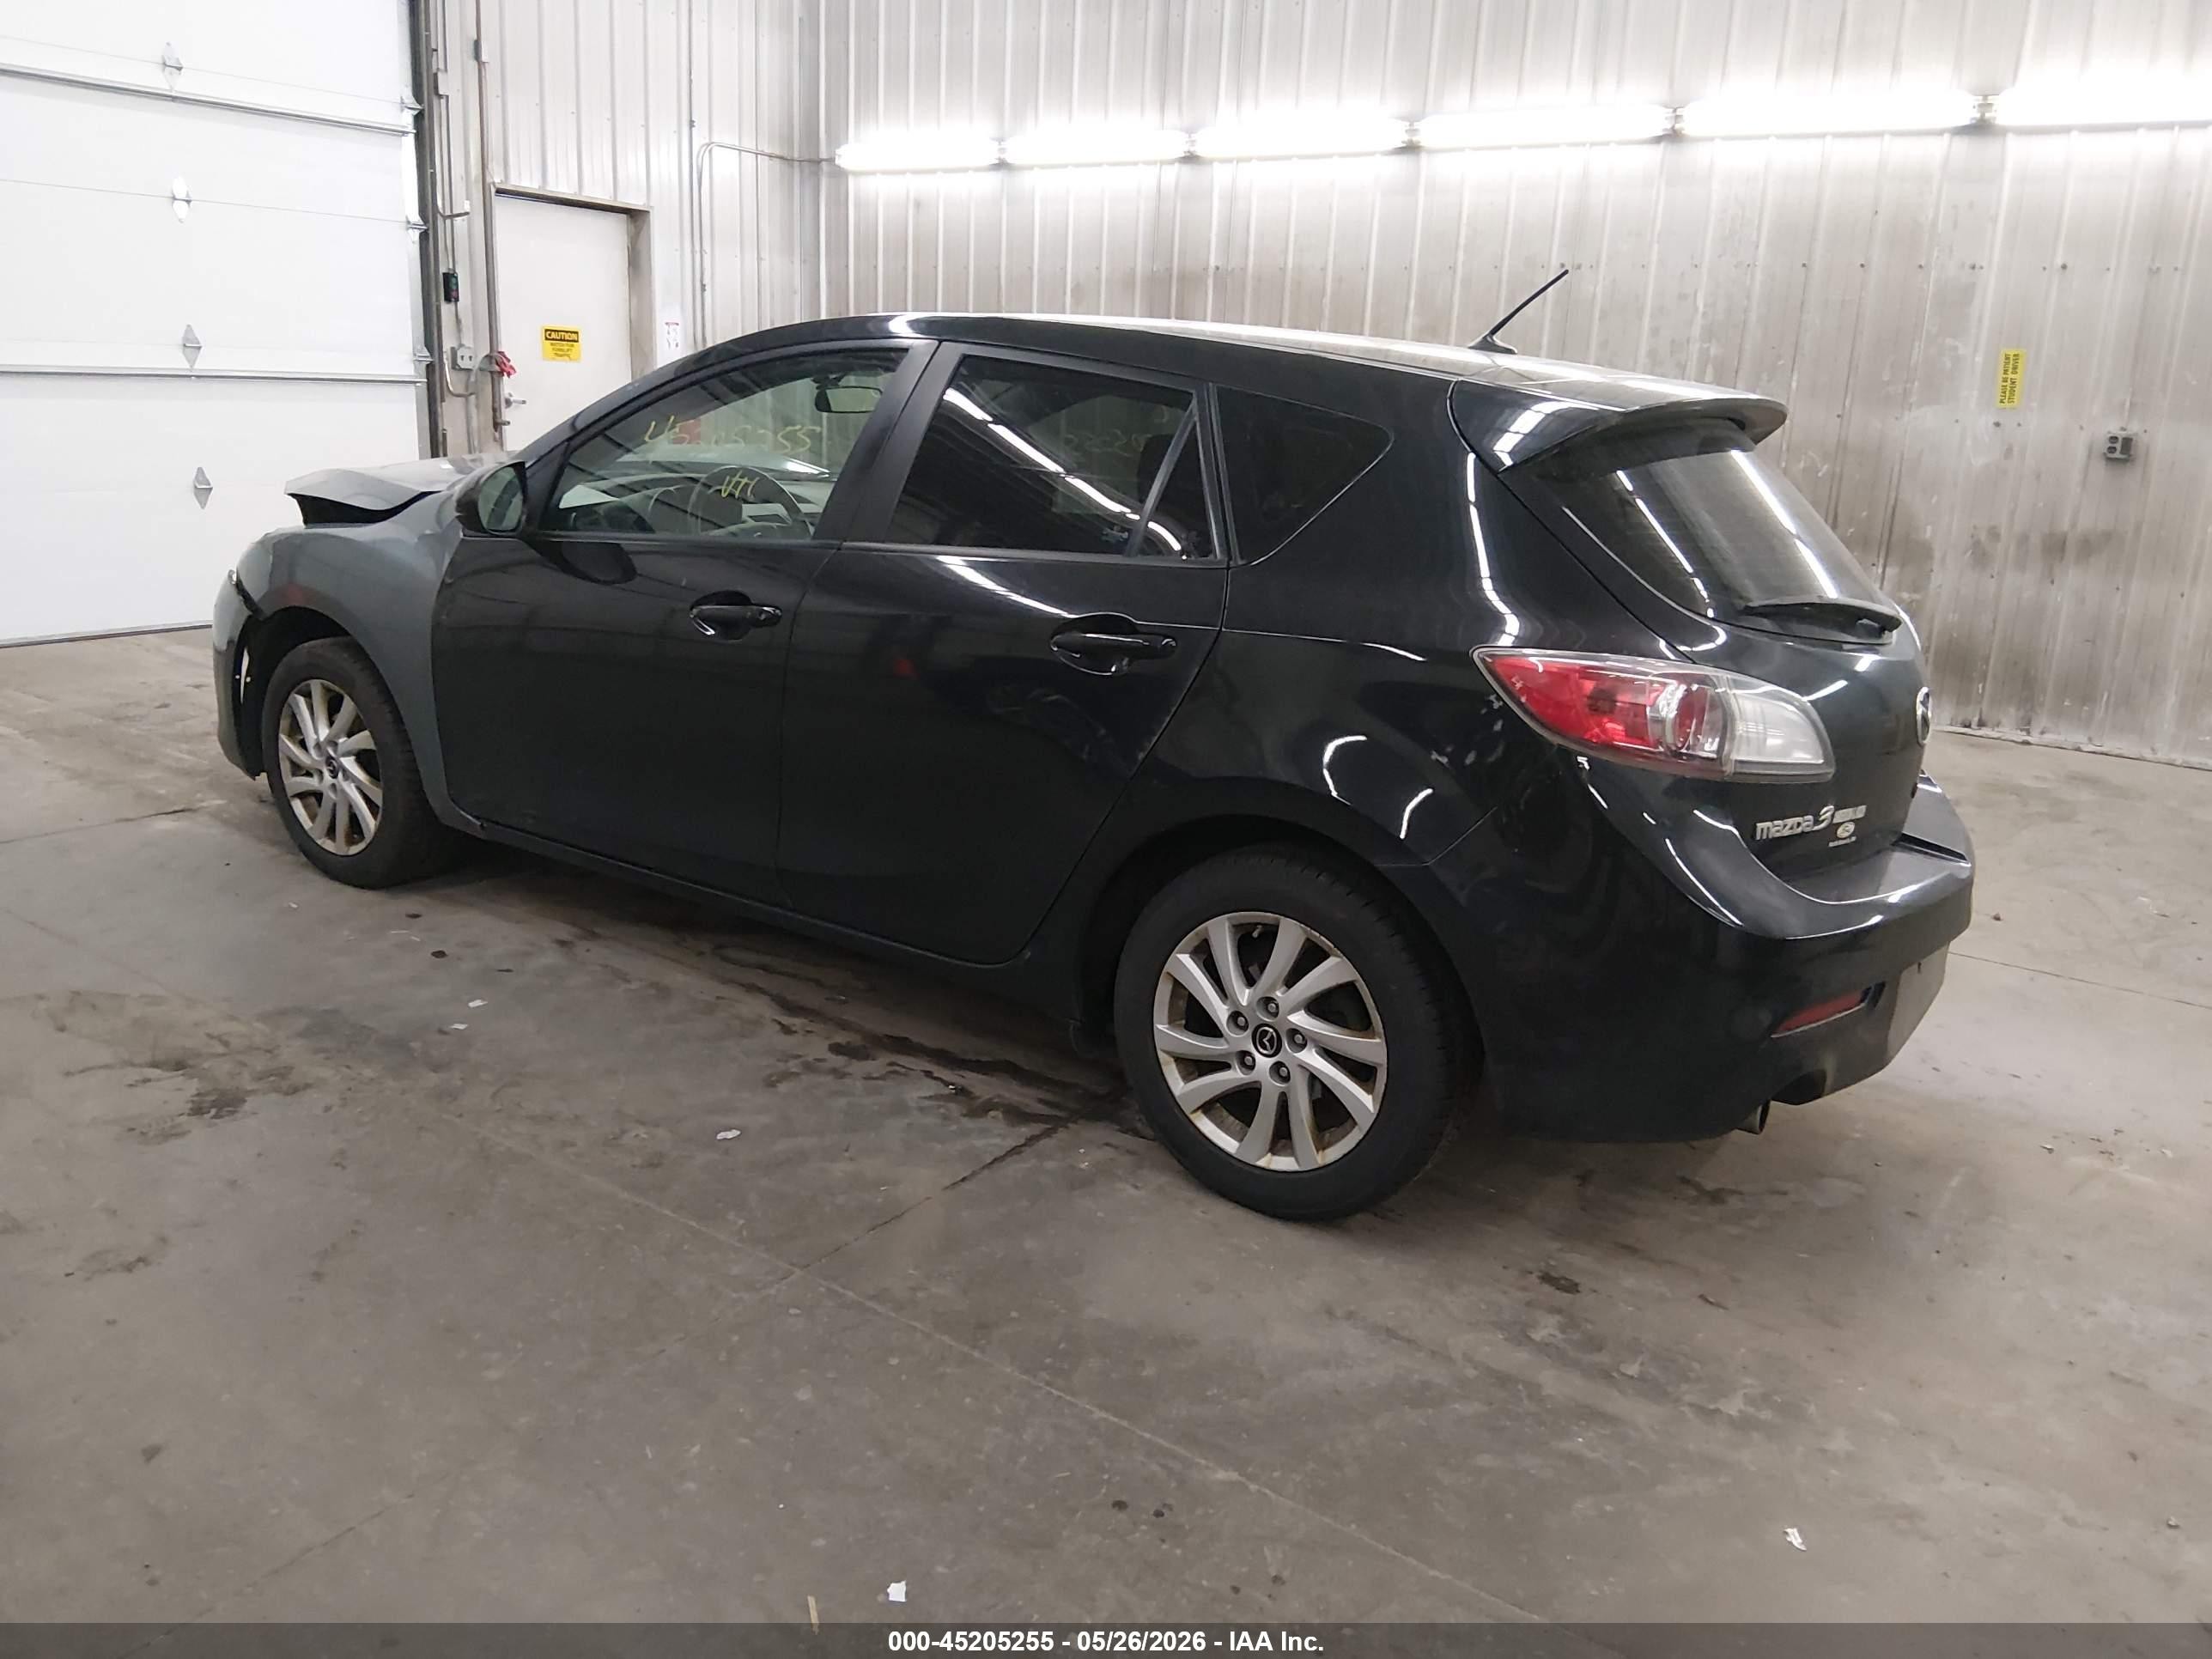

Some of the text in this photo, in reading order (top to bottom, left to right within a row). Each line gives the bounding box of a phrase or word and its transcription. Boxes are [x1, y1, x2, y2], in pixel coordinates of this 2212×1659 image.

[546, 331, 578, 341] CAUTION
[2007, 354, 2020, 404] STUDENT DRIVER
[1999, 385, 2008, 404] PLEASE
